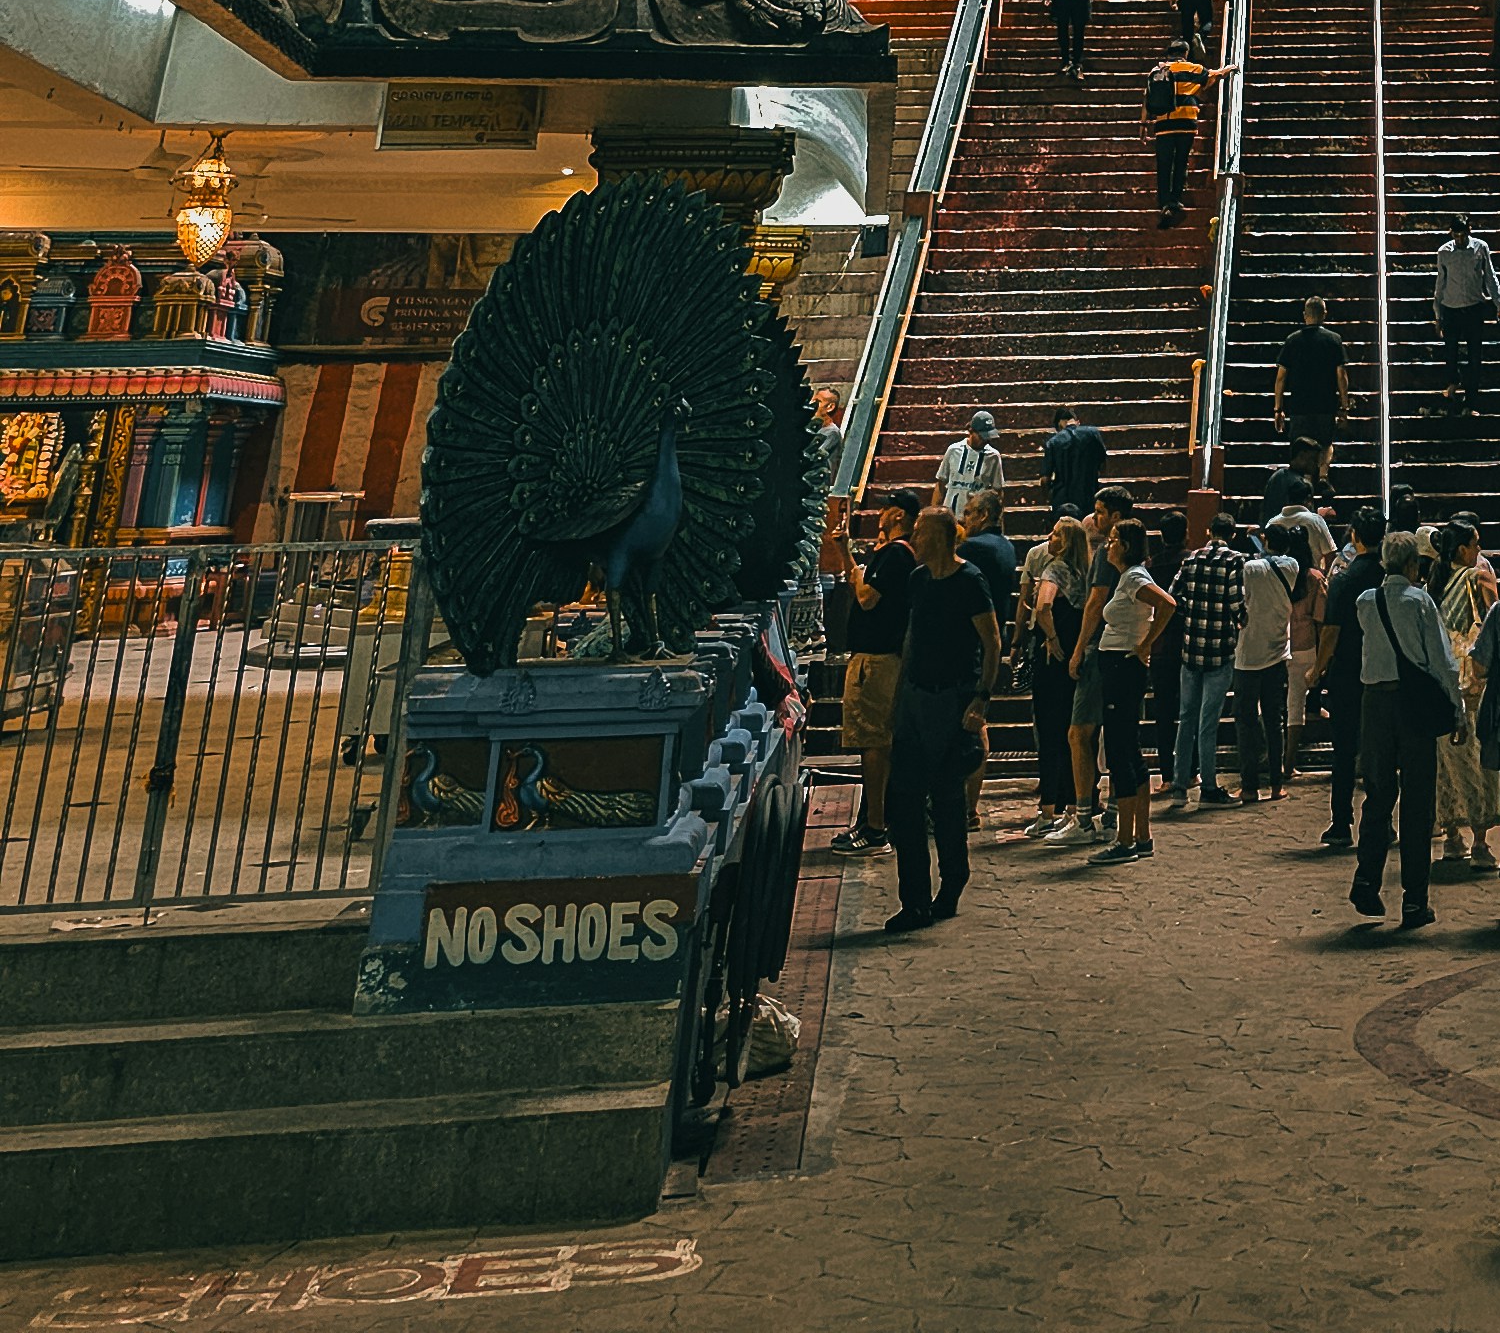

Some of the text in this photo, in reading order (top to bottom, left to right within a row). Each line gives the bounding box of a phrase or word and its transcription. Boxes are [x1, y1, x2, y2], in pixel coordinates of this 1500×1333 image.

[384, 114, 489, 129] MAIN TEMPLE
[394, 308, 471, 318] PRINTING & SIG
[423, 899, 679, 970] NO SHOES
[28, 1238, 703, 1328] SHOES
